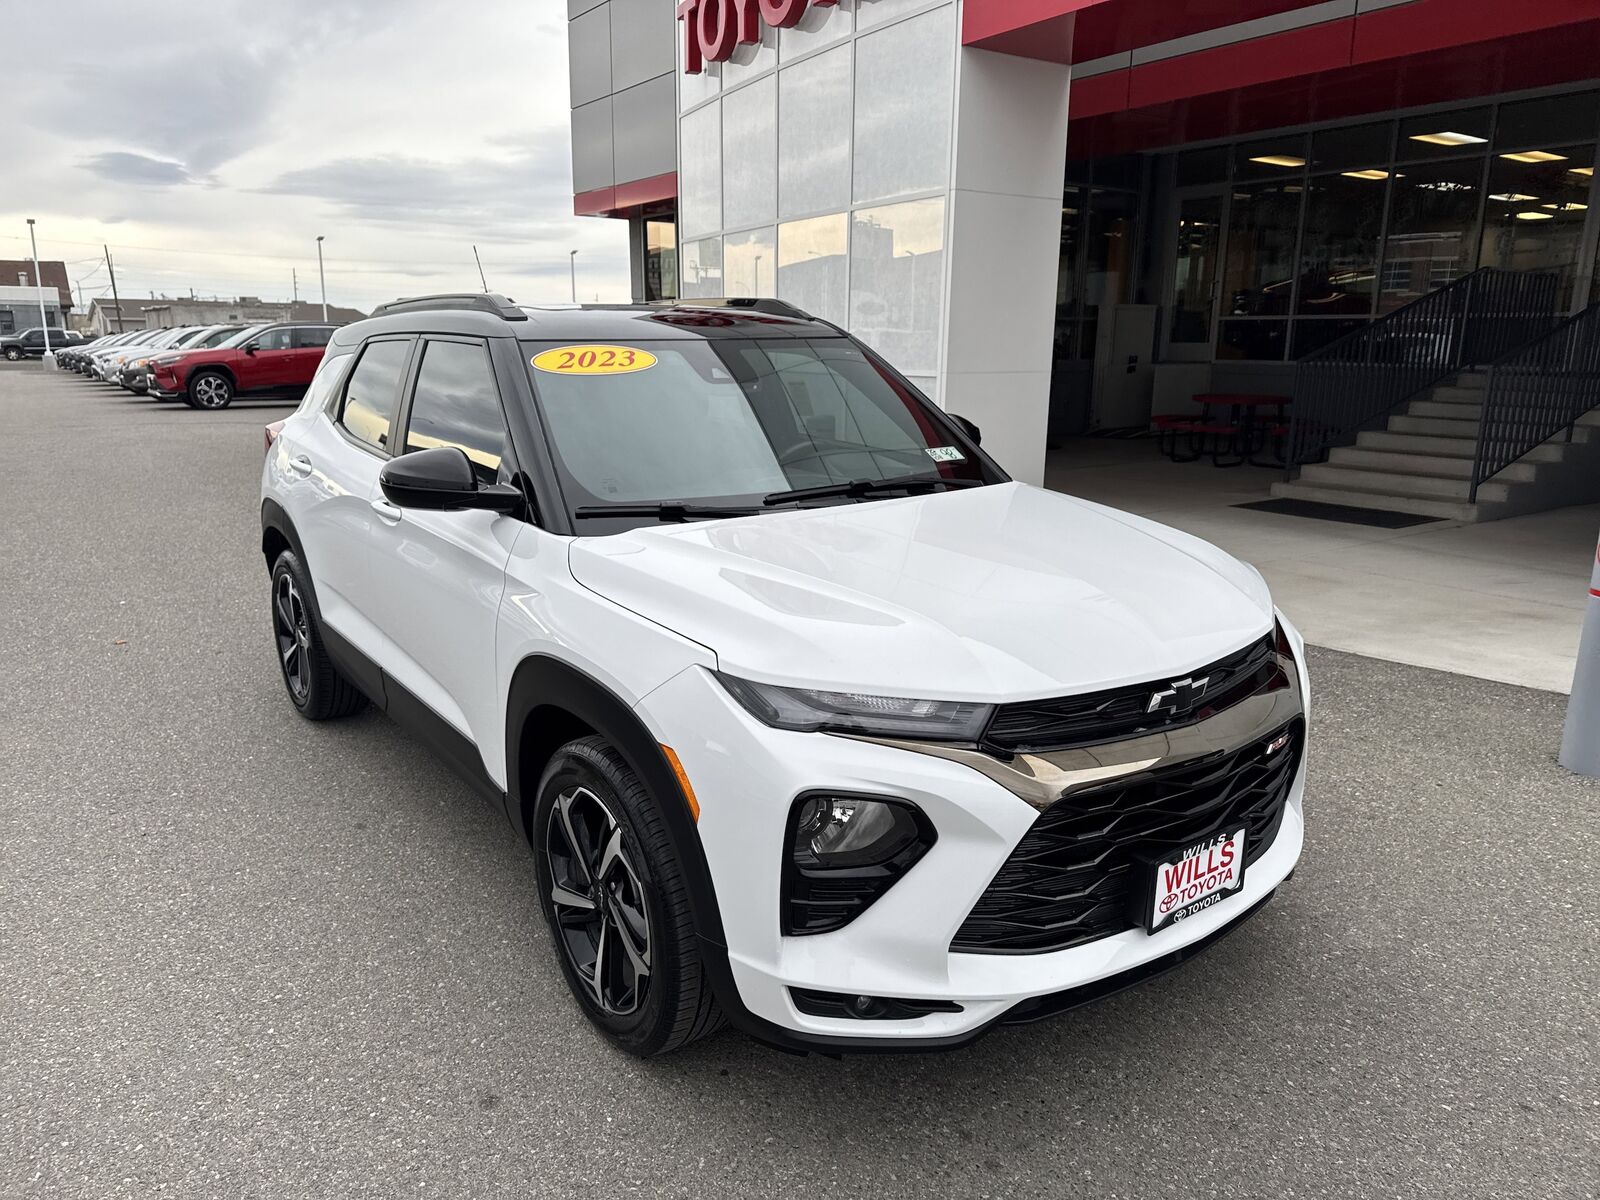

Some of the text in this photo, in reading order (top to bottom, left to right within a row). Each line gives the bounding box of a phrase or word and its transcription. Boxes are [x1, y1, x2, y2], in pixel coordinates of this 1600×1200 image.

[677, 0, 838, 75] TOY
[557, 351, 636, 369] 2023
[1183, 833, 1227, 860] WILLS
[1164, 840, 1235, 893] WILLS
[1180, 867, 1233, 903] TOYOTA
[1187, 893, 1221, 915] TOYOTA
